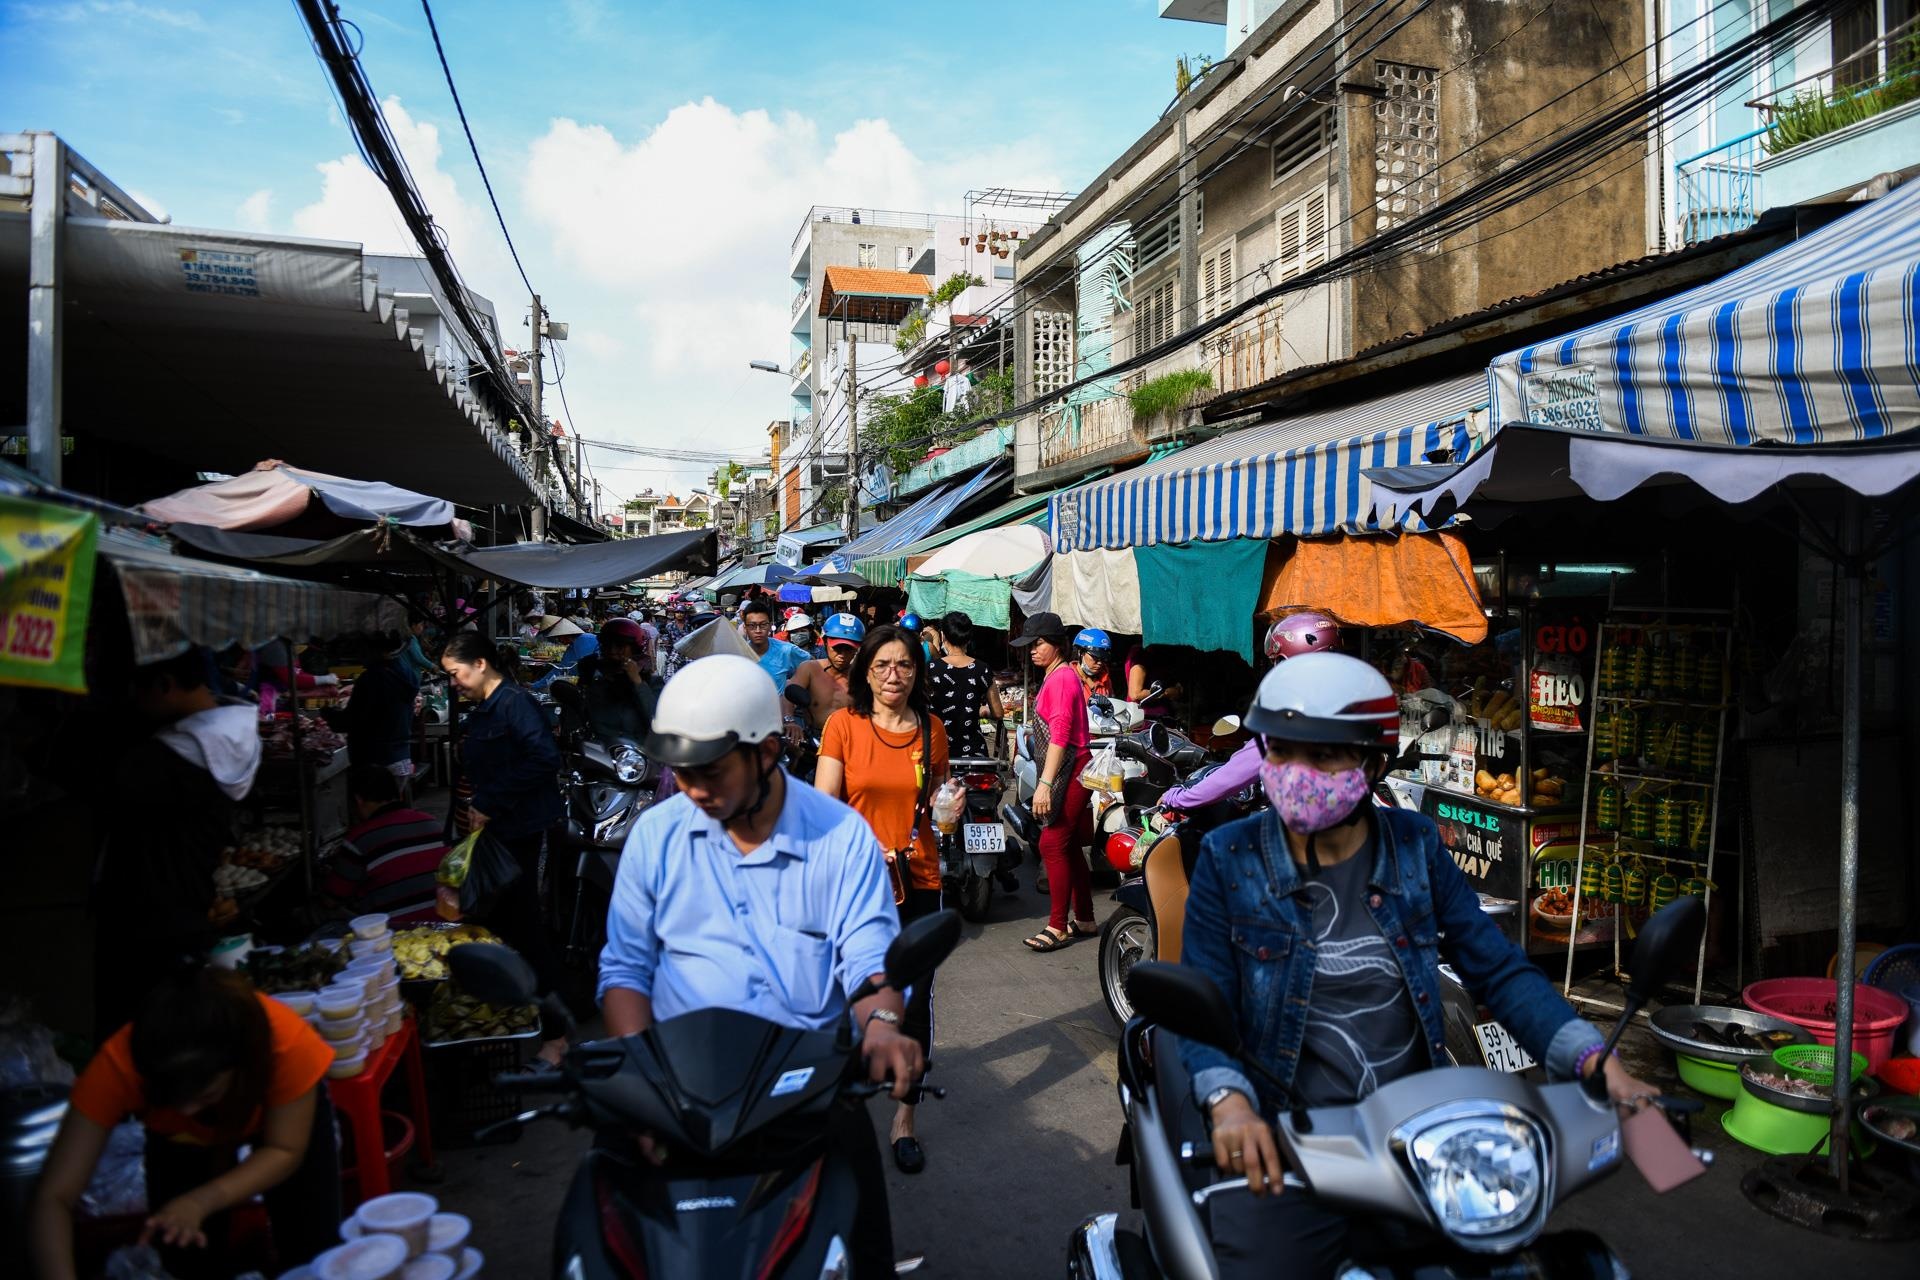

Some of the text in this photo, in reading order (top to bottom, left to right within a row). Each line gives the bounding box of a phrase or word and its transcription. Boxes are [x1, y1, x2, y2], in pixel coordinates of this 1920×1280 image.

[1538, 674, 1585, 706] HEO
[970, 825, 997, 838] 59-P1
[1466, 830, 1483, 855] CHẢ
[1446, 848, 1491, 880] UAY
[1482, 1024, 1513, 1048] 59-
[1487, 1044, 1534, 1072] 874.7
